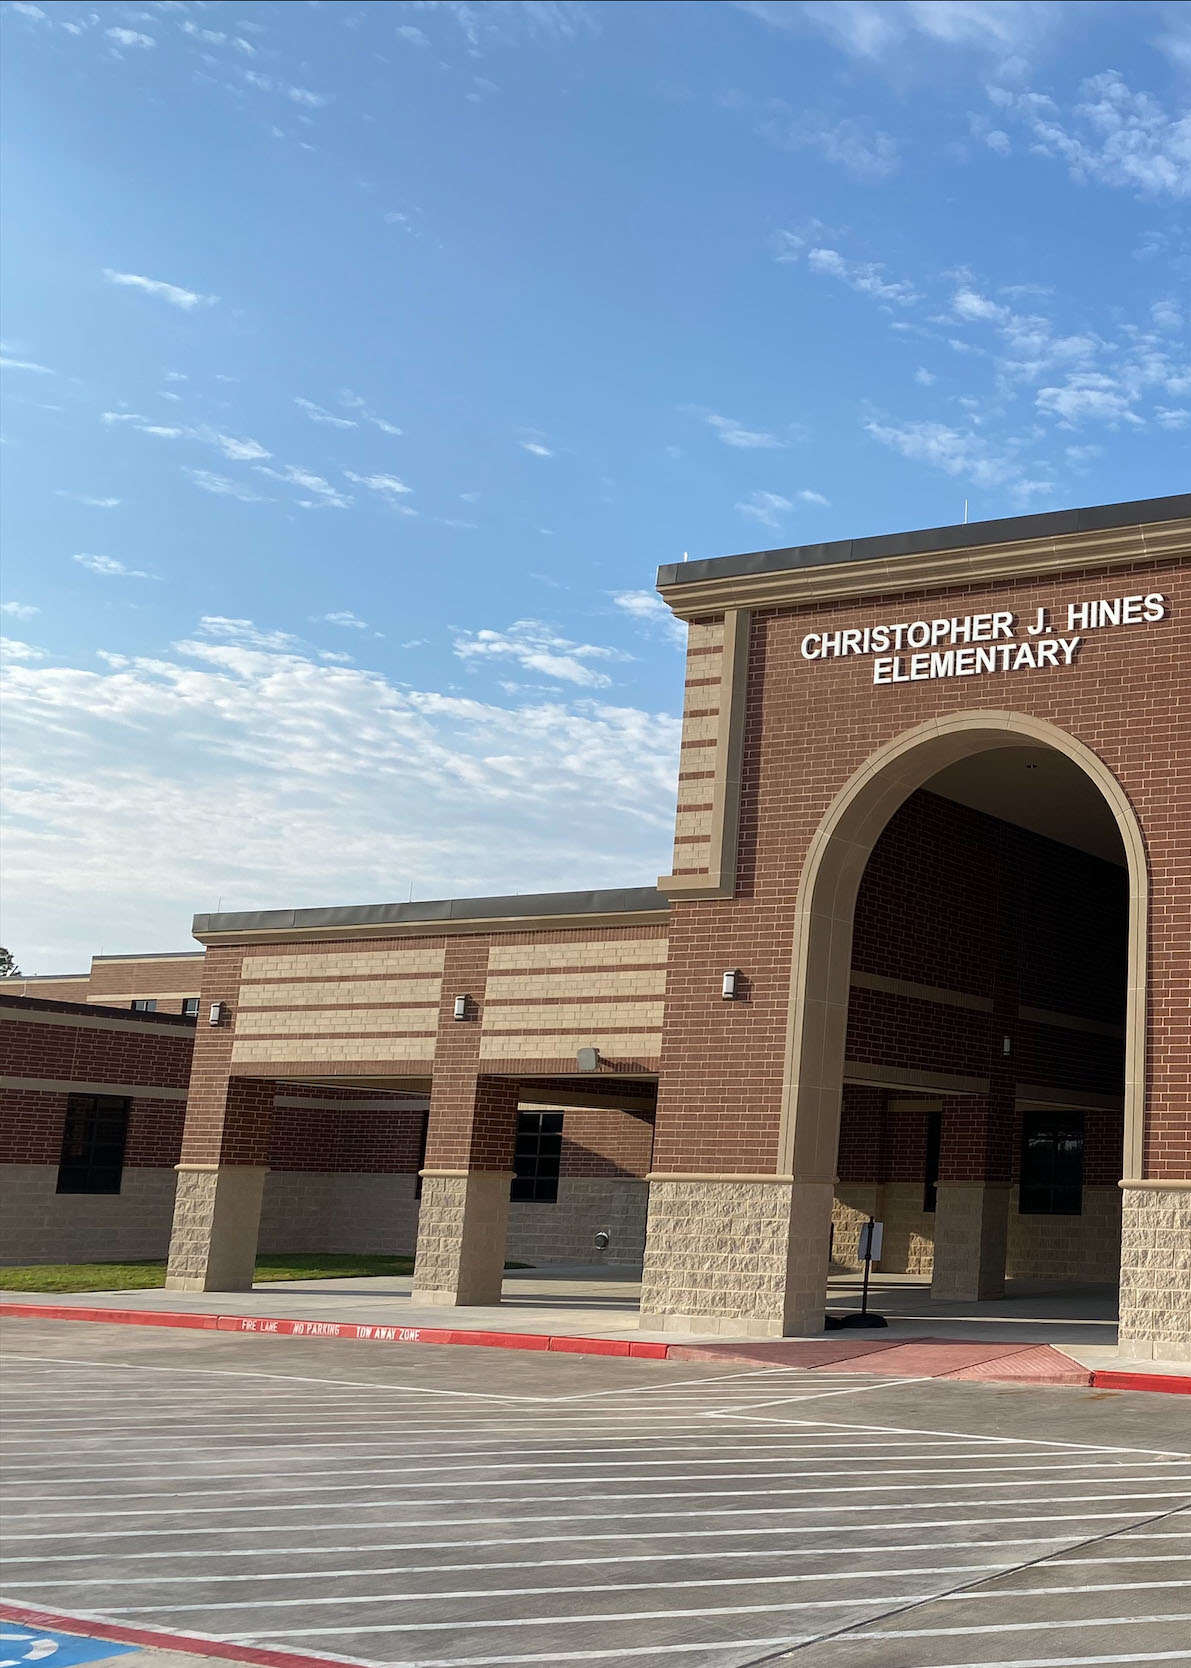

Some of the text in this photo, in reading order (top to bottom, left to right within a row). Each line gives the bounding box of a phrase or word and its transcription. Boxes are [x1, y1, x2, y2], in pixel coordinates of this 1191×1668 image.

[800, 593, 1165, 660] CHRISTOPHER J. HINES
[872, 636, 1081, 685] ELEMENTARY
[241, 1319, 420, 1342] FIRE LANE NO PARKING TOW AWAY ZONE
